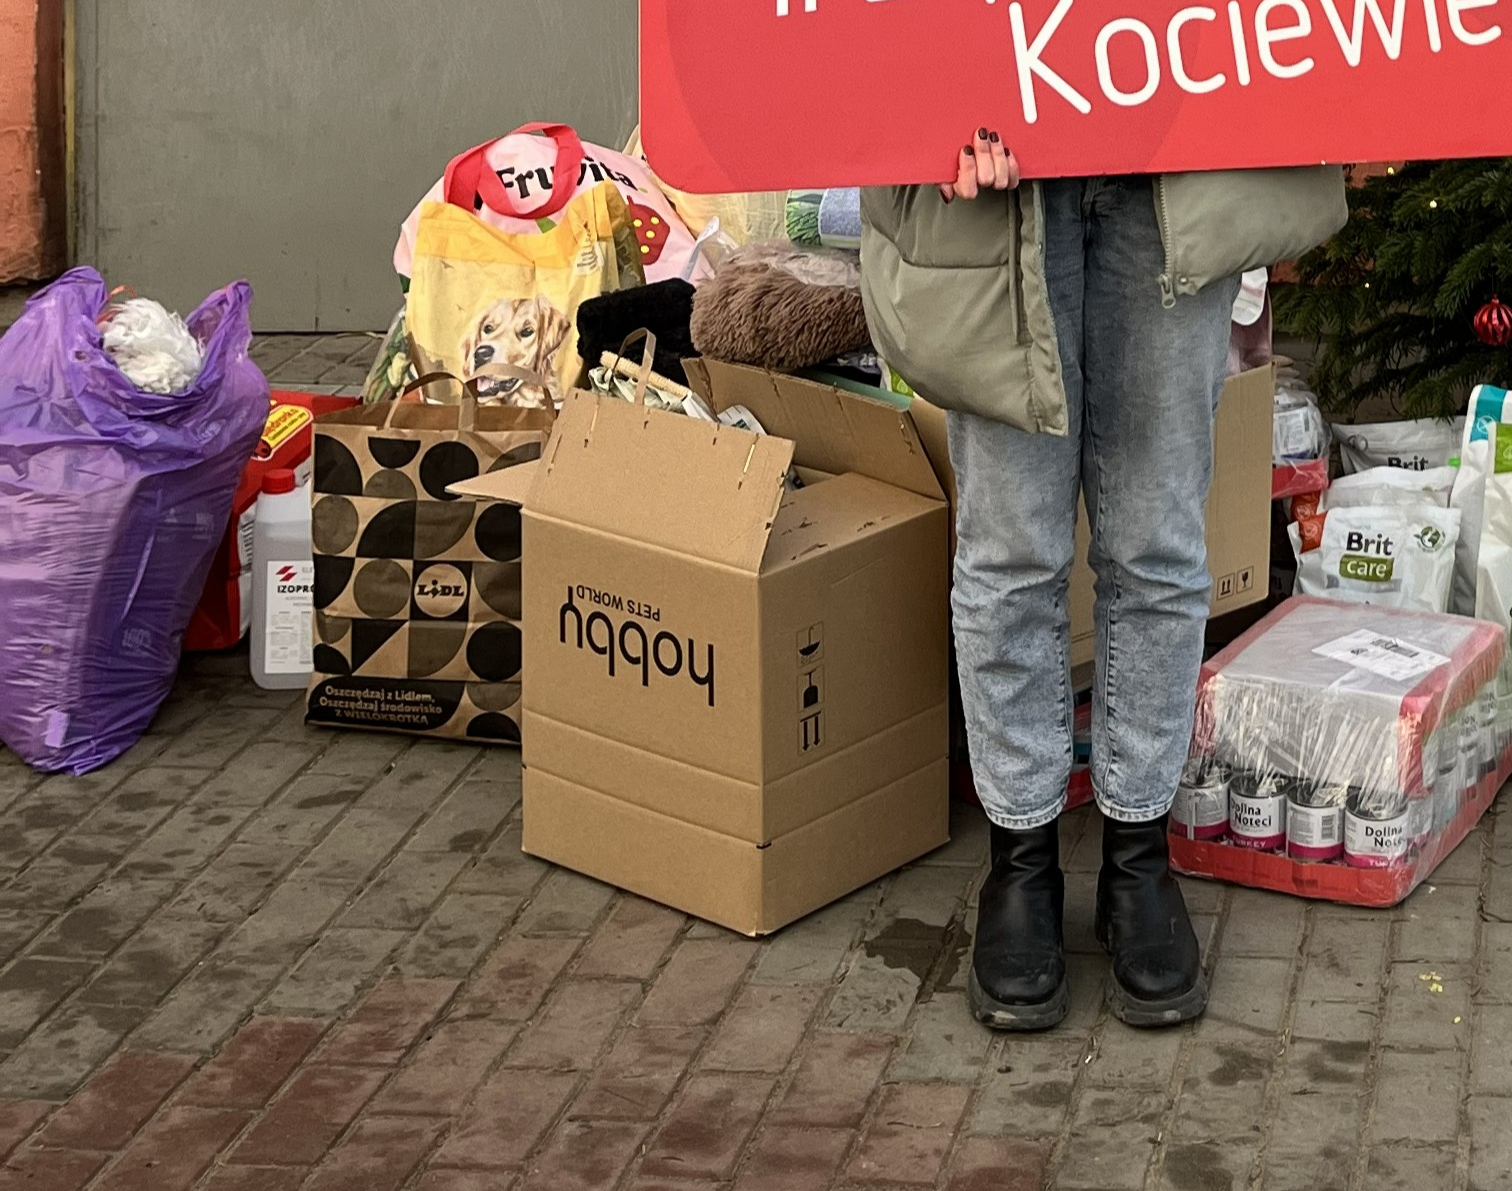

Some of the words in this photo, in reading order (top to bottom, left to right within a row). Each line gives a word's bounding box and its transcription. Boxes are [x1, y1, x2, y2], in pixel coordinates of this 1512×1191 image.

[1346, 531, 1393, 556] Brit
[1346, 560, 1387, 577] care
[576, 584, 624, 611] WORLD
[627, 599, 660, 622] PETS
[559, 585, 715, 707] hobby
[324, 685, 385, 702] Oszczędzaj
[319, 696, 378, 712] Oszczędzaj
[1234, 811, 1272, 828] Noteci
